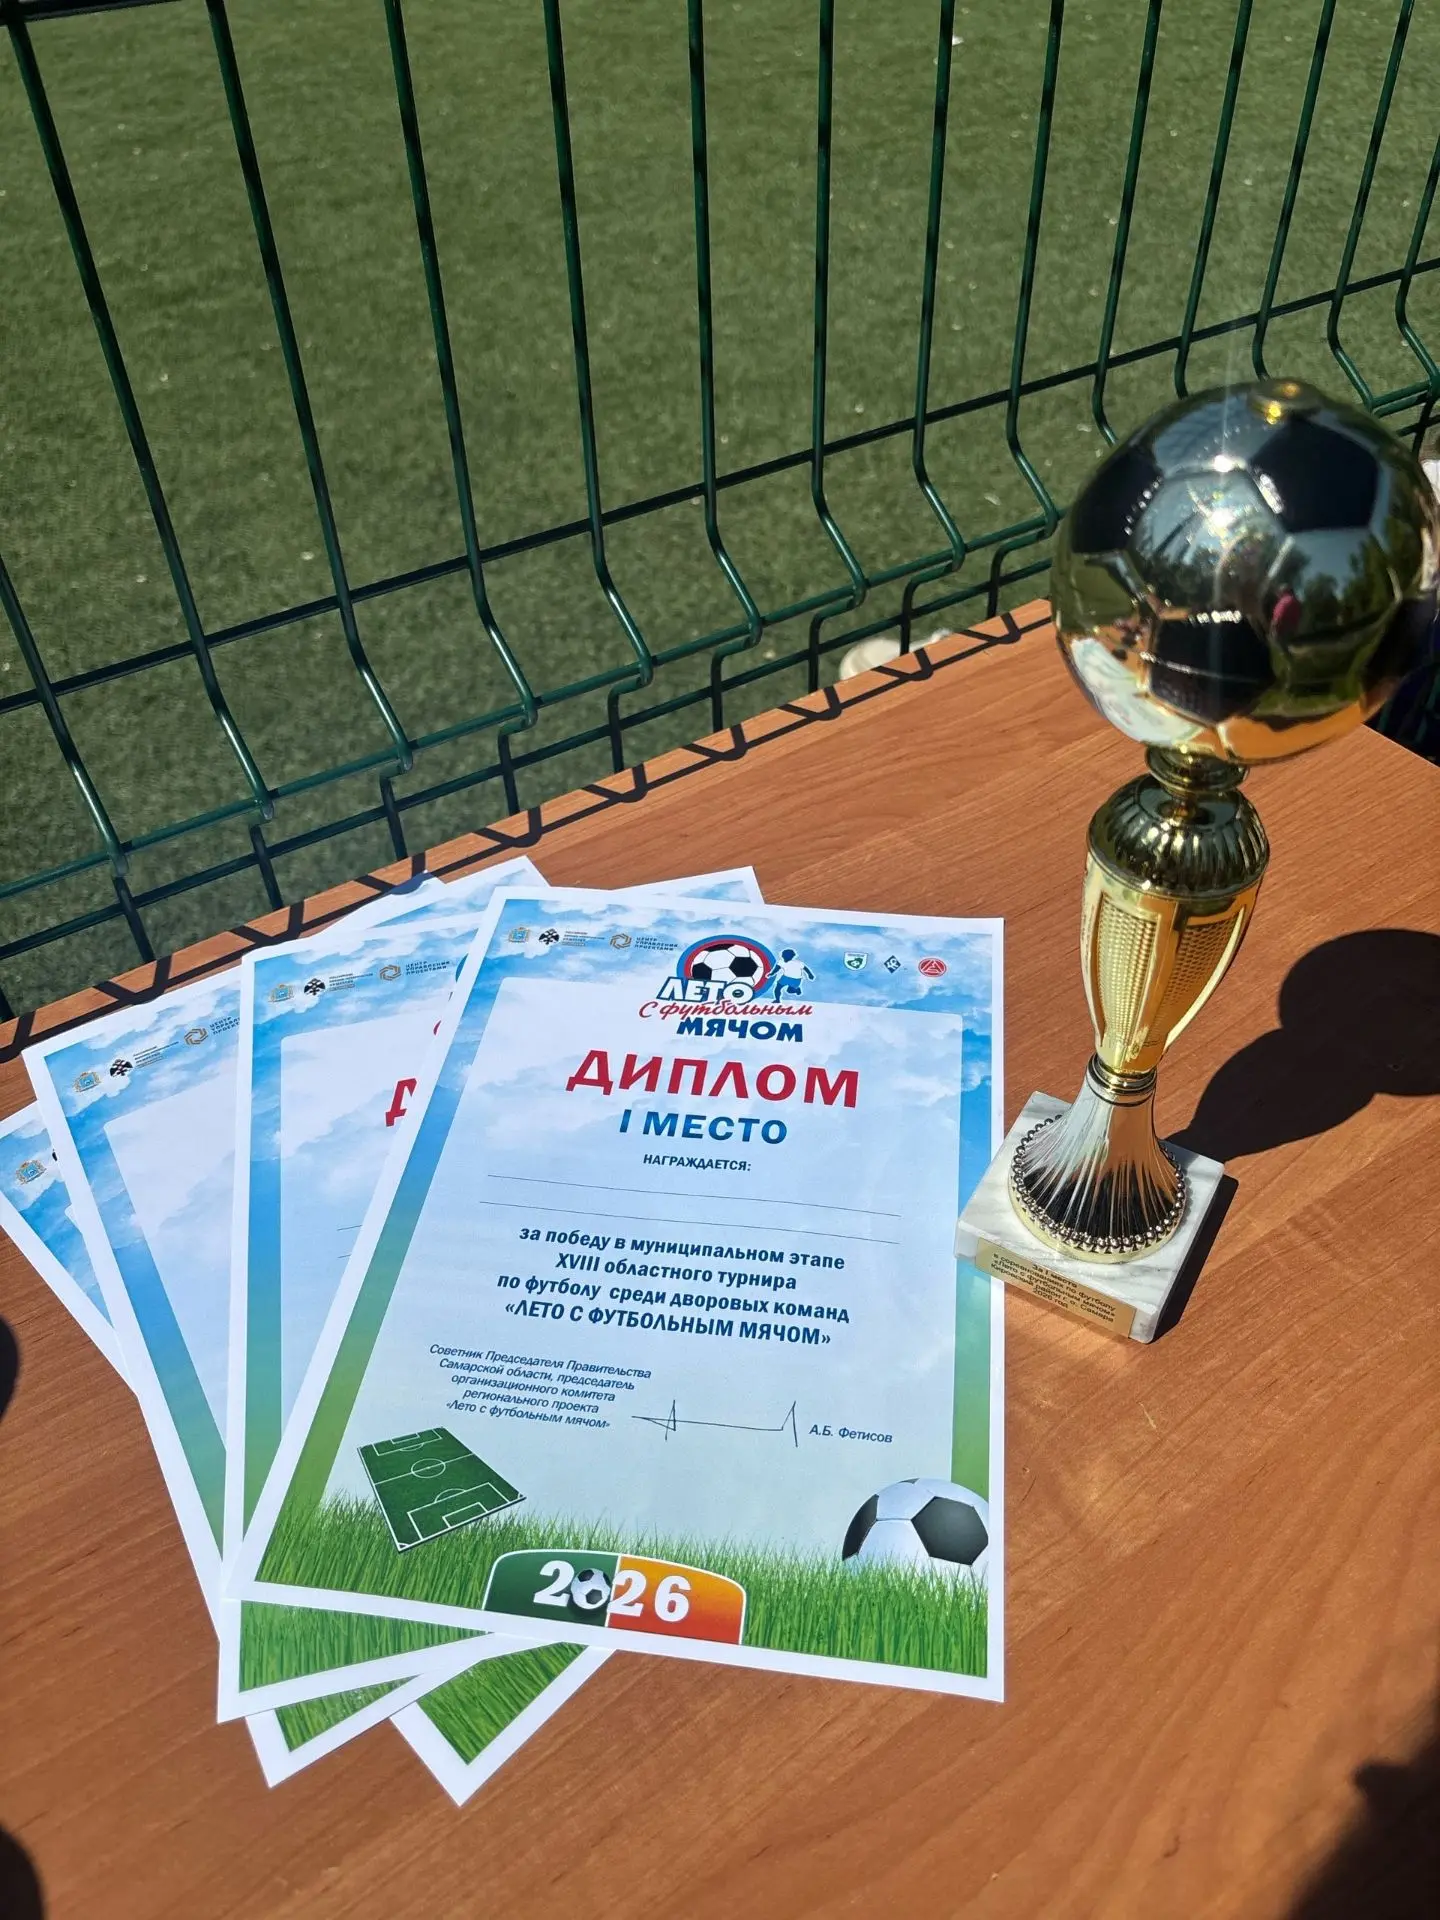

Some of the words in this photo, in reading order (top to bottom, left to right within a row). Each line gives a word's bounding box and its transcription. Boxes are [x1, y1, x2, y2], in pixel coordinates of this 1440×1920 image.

[656, 976, 753, 1005] ЛЕТО
[659, 1000, 813, 1020] футбольным
[677, 1017, 803, 1042] МЯЧОМ
[566, 1050, 860, 1108] ДИПЛОМ
[619, 1110, 631, 1133] I
[643, 1111, 787, 1145] МЕСТО
[643, 1154, 751, 1172] НАГРАЖДАЕТСЯ:
[519, 1228, 541, 1242] за
[546, 1230, 610, 1251] победу
[614, 1238, 625, 1249] в
[630, 1239, 785, 1263] муниципальном
[789, 1251, 845, 1271] этапе
[556, 1253, 600, 1271] XVIII
[605, 1258, 713, 1283] областного
[718, 1269, 797, 1291] турнира
[497, 1275, 520, 1289] по
[525, 1275, 601, 1300] футболу
[610, 1286, 666, 1306] среди
[669, 1292, 769, 1314] дворовых
[774, 1302, 850, 1324] команд
[505, 1300, 565, 1320] «ЛЕТО
[570, 1306, 583, 1322] С
[588, 1306, 733, 1336] ФУТБОЛЬНЫМ
[739, 1320, 831, 1346] МЯЧОМ»
[430, 1344, 482, 1359] Советник
[485, 1351, 564, 1369] Председателя
[566, 1360, 651, 1378] Правительства
[440, 1358, 503, 1375] Самарской
[507, 1367, 553, 1381] области,
[557, 1373, 634, 1390] председатель
[451, 1375, 558, 1395] организационного
[561, 1388, 615, 1401] комитета
[463, 1389, 549, 1407] регионального
[551, 1401, 599, 1413] проекта
[447, 1400, 476, 1412] «Лето
[490, 1406, 562, 1423] футбольным
[565, 1415, 610, 1428] мячом»
[809, 1425, 834, 1437] А.Б.
[839, 1428, 893, 1443] Фетисов
